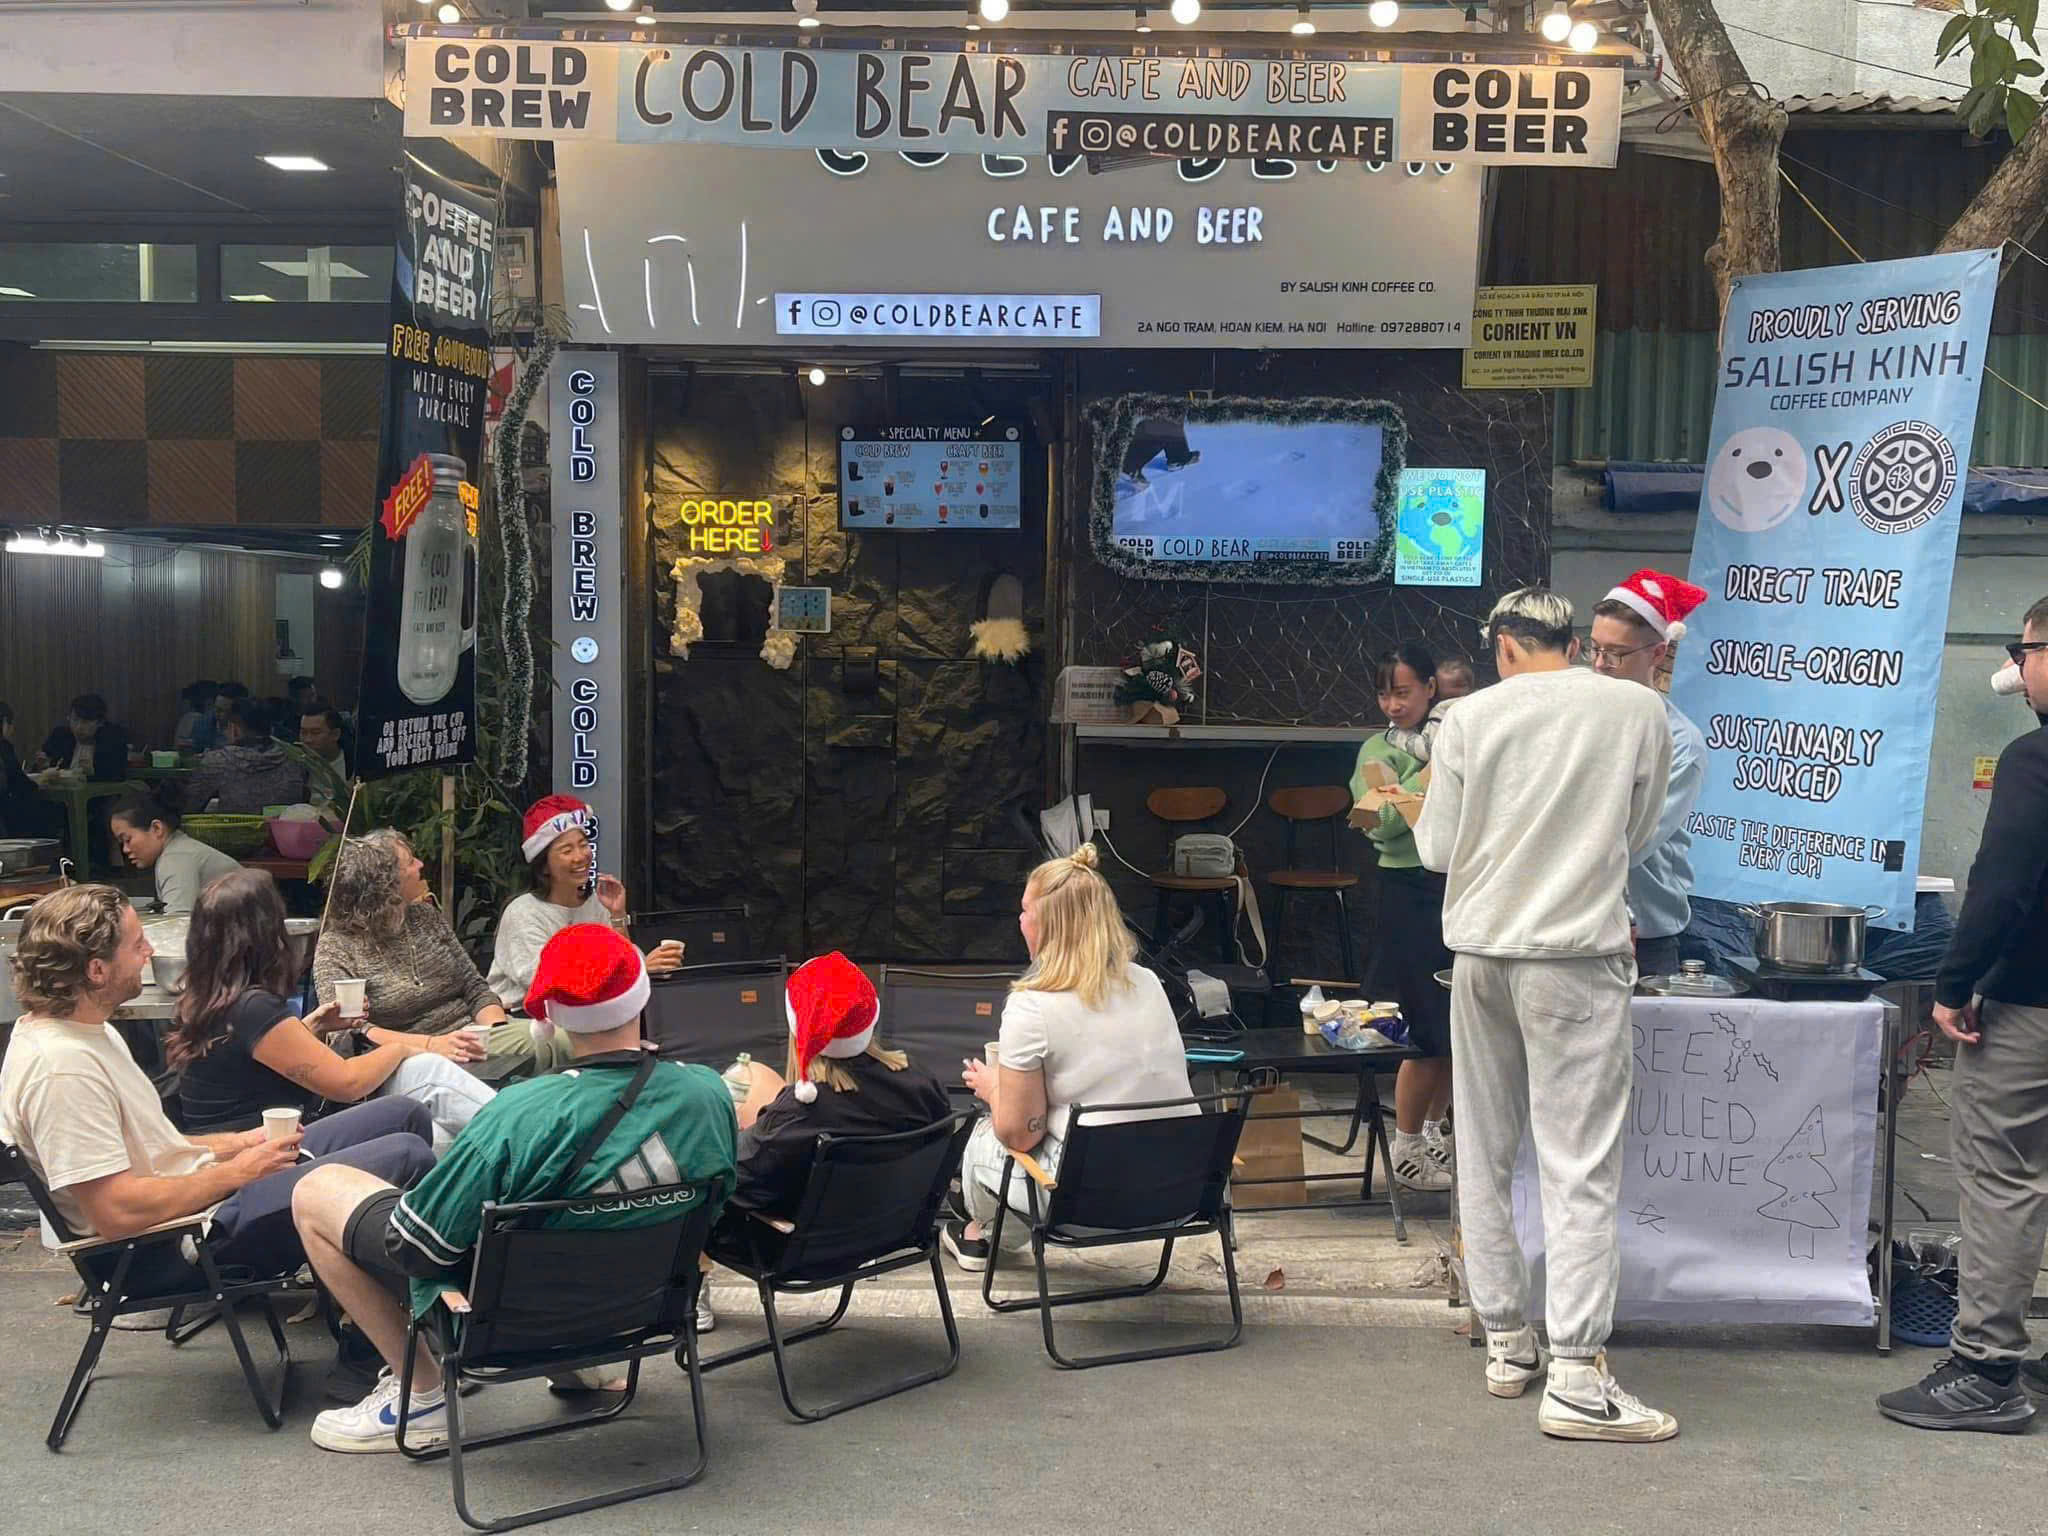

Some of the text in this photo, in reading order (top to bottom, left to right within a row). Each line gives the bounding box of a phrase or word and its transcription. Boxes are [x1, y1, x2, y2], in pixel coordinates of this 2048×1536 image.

[435, 44, 587, 85] COLD
[1068, 57, 1347, 104] CAFE AND BEER
[430, 87, 591, 129] BREW
[635, 50, 1027, 139] COLD BEAR
[1433, 69, 1590, 109] COLD
[1115, 121, 1387, 156] @COLDBEARCAFE
[1433, 113, 1588, 154] BEER
[405, 183, 492, 252] COFFEE
[987, 205, 1264, 245] CAFE AND BEER
[423, 234, 474, 281] AND
[416, 269, 476, 321] BEER
[1281, 282, 1437, 293] BY SALISH KINH COFFEE CO.
[849, 303, 1083, 330] @COLDBEARCAFE
[1137, 322, 1153, 333] 2A
[1156, 322, 1180, 333] NGO
[1184, 322, 1217, 335] TRAM,
[1220, 322, 1251, 333] HOAN
[1288, 322, 1304, 333] HA
[1308, 322, 1327, 333] NOI
[1380, 322, 1461, 333] 0972880714
[1483, 322, 1576, 341] CORIENT VN
[1748, 290, 1961, 343] PROUDLY SERVING
[392, 323, 430, 364] FREE
[1725, 340, 1968, 388] SALISH KINH
[413, 369, 474, 404] WITH EVERY
[1770, 386, 1914, 411] COFFEE COMPANY
[418, 397, 469, 428] PURCHASE
[569, 370, 596, 482] COLD
[855, 444, 911, 457] COLD BREW
[888, 427, 970, 440] SPECIALTY MENU
[946, 444, 1004, 457] CRAFT BEER
[394, 459, 430, 527] FREE!
[1400, 486, 1424, 497] USE
[680, 500, 773, 525] ORDER
[690, 528, 760, 552] HERE
[1163, 539, 1204, 556] COLD
[1211, 538, 1250, 557] BEAR
[570, 511, 598, 621] BREW
[1725, 564, 1903, 609] DIRECT TRADE
[1706, 640, 1904, 688] SINGLE-ORIGIN
[570, 678, 597, 787] COLD
[1706, 713, 1884, 767] SUSTAINABLY
[1733, 755, 1842, 803] SOURCED
[1685, 811, 1737, 841] TASTE
[1741, 820, 1769, 846] THE
[1771, 825, 1865, 862] DIFFERENCE
[1739, 844, 1822, 880] EVERY CUP!
[1631, 1024, 1714, 1075] REE
[1644, 1144, 1754, 1186] WINE
